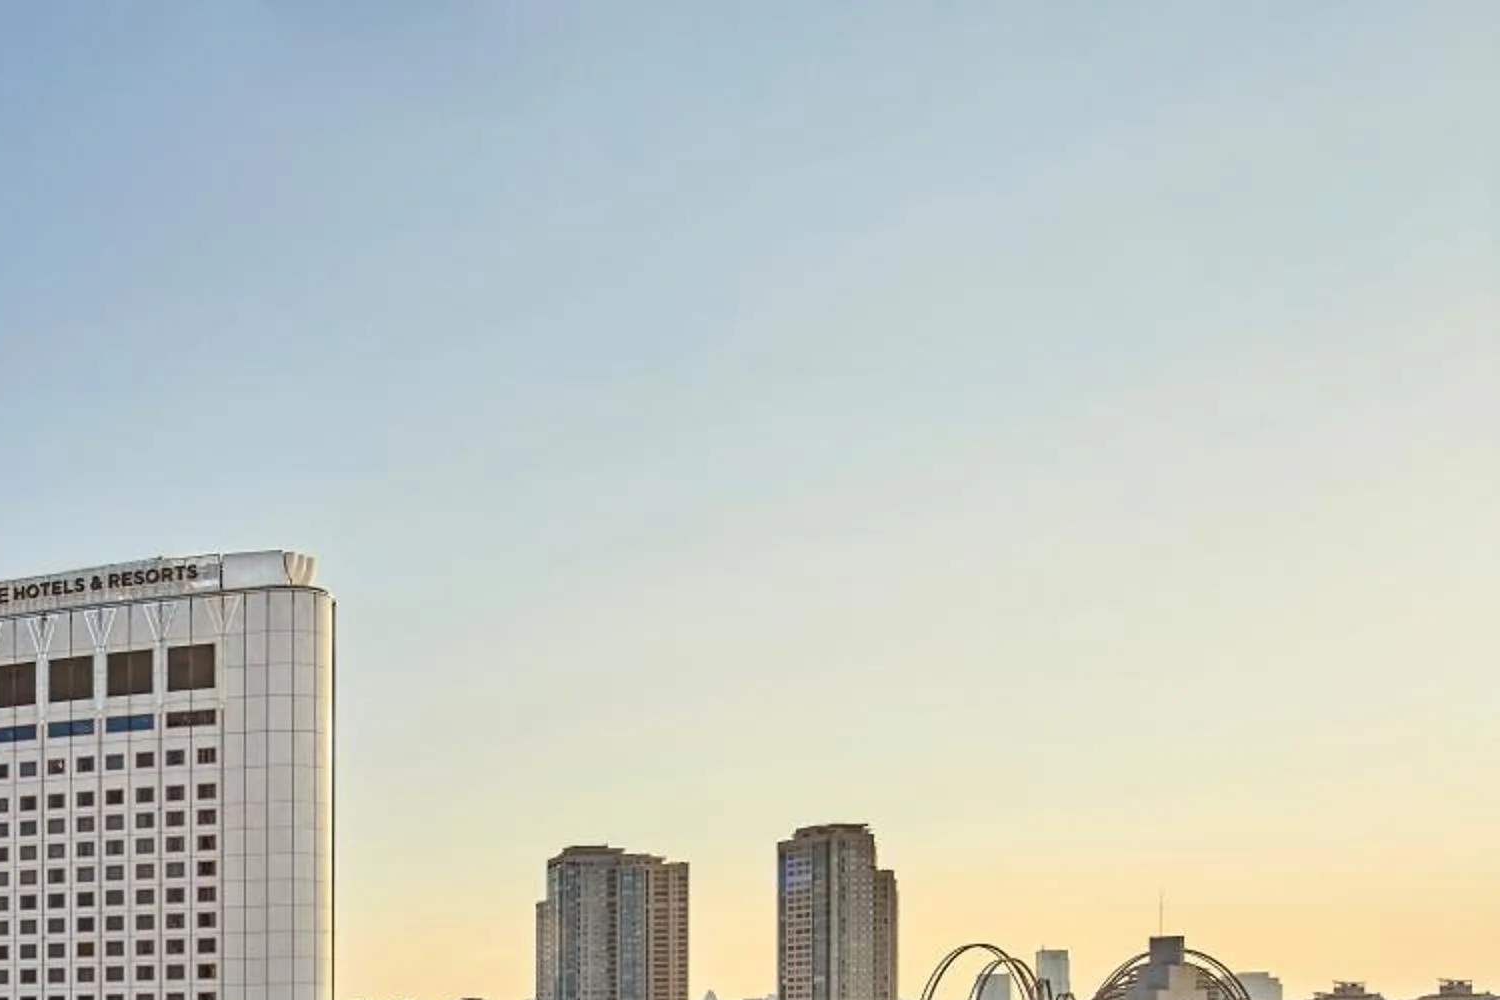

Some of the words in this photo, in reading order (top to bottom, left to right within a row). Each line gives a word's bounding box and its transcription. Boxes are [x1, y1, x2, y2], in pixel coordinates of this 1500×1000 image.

[13, 577, 85, 600] HOTELS
[90, 575, 102, 590] &
[108, 563, 198, 588] RESORTS
